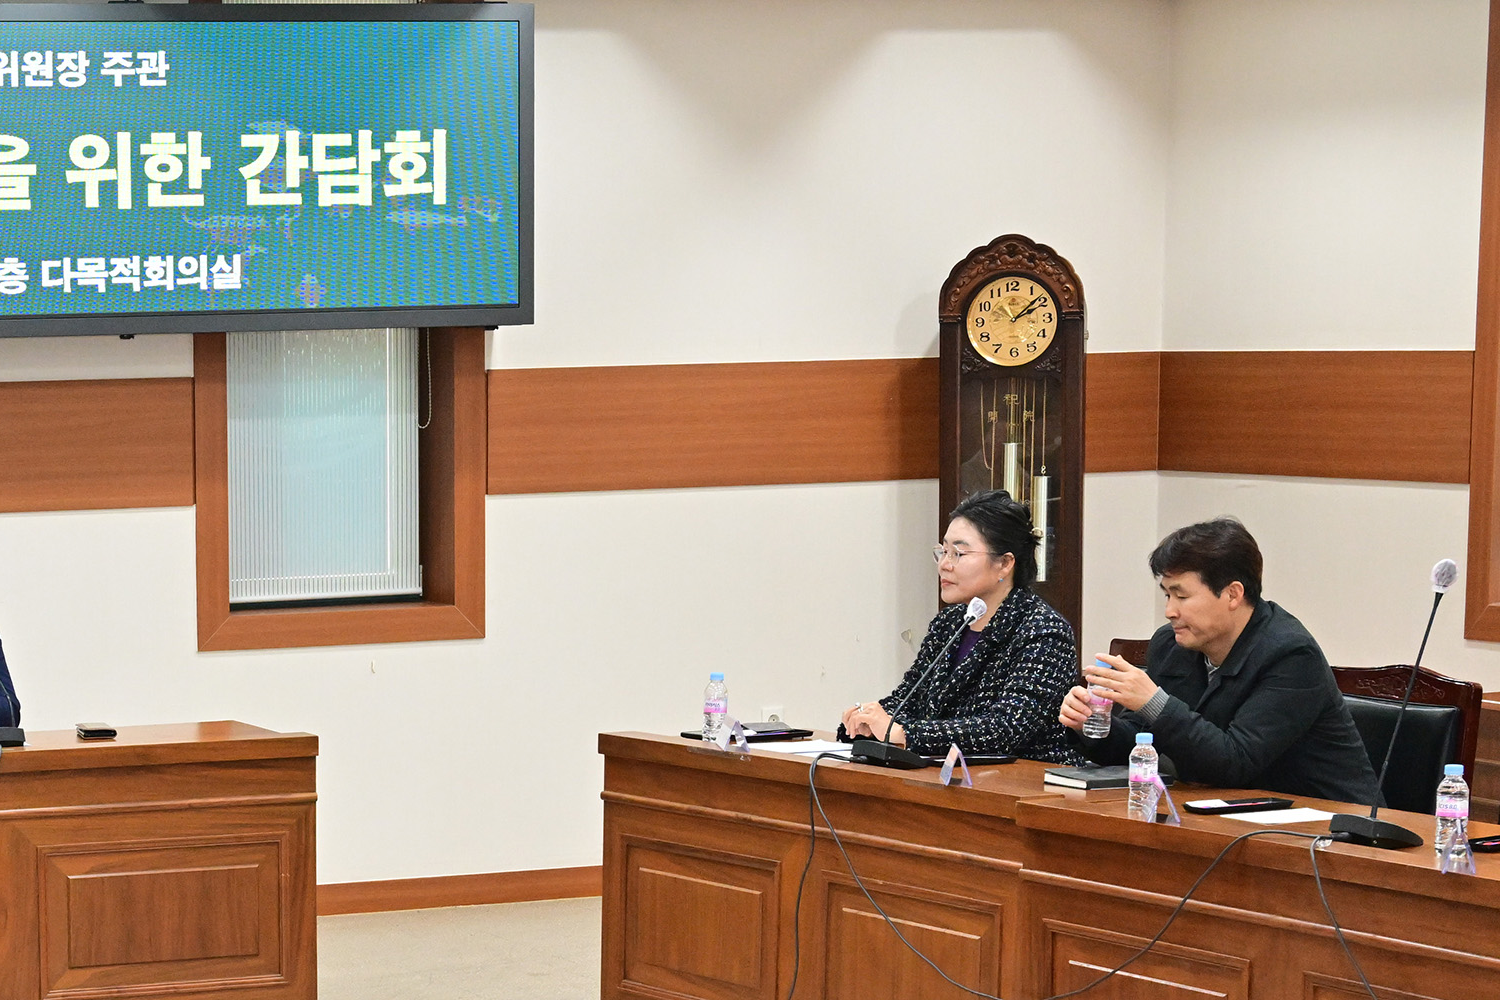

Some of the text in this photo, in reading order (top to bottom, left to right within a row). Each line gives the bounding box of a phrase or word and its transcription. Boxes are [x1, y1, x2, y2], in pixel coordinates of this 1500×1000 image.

[101, 51, 171, 88] 주관
[66, 132, 212, 211] 위한
[240, 129, 448, 208] 간담회
[42, 254, 243, 294] 다목적회의실
[1005, 281, 1020, 292] 12
[990, 288, 1002, 298] 11
[979, 301, 991, 312] 10
[1038, 296, 1049, 307] 2
[975, 317, 985, 328] 9
[1042, 313, 1053, 324] 3
[979, 331, 990, 342] 8
[1036, 328, 1047, 338] 4
[992, 343, 1003, 354] 7
[1009, 347, 1020, 358] 6
[1026, 341, 1037, 353] 5
